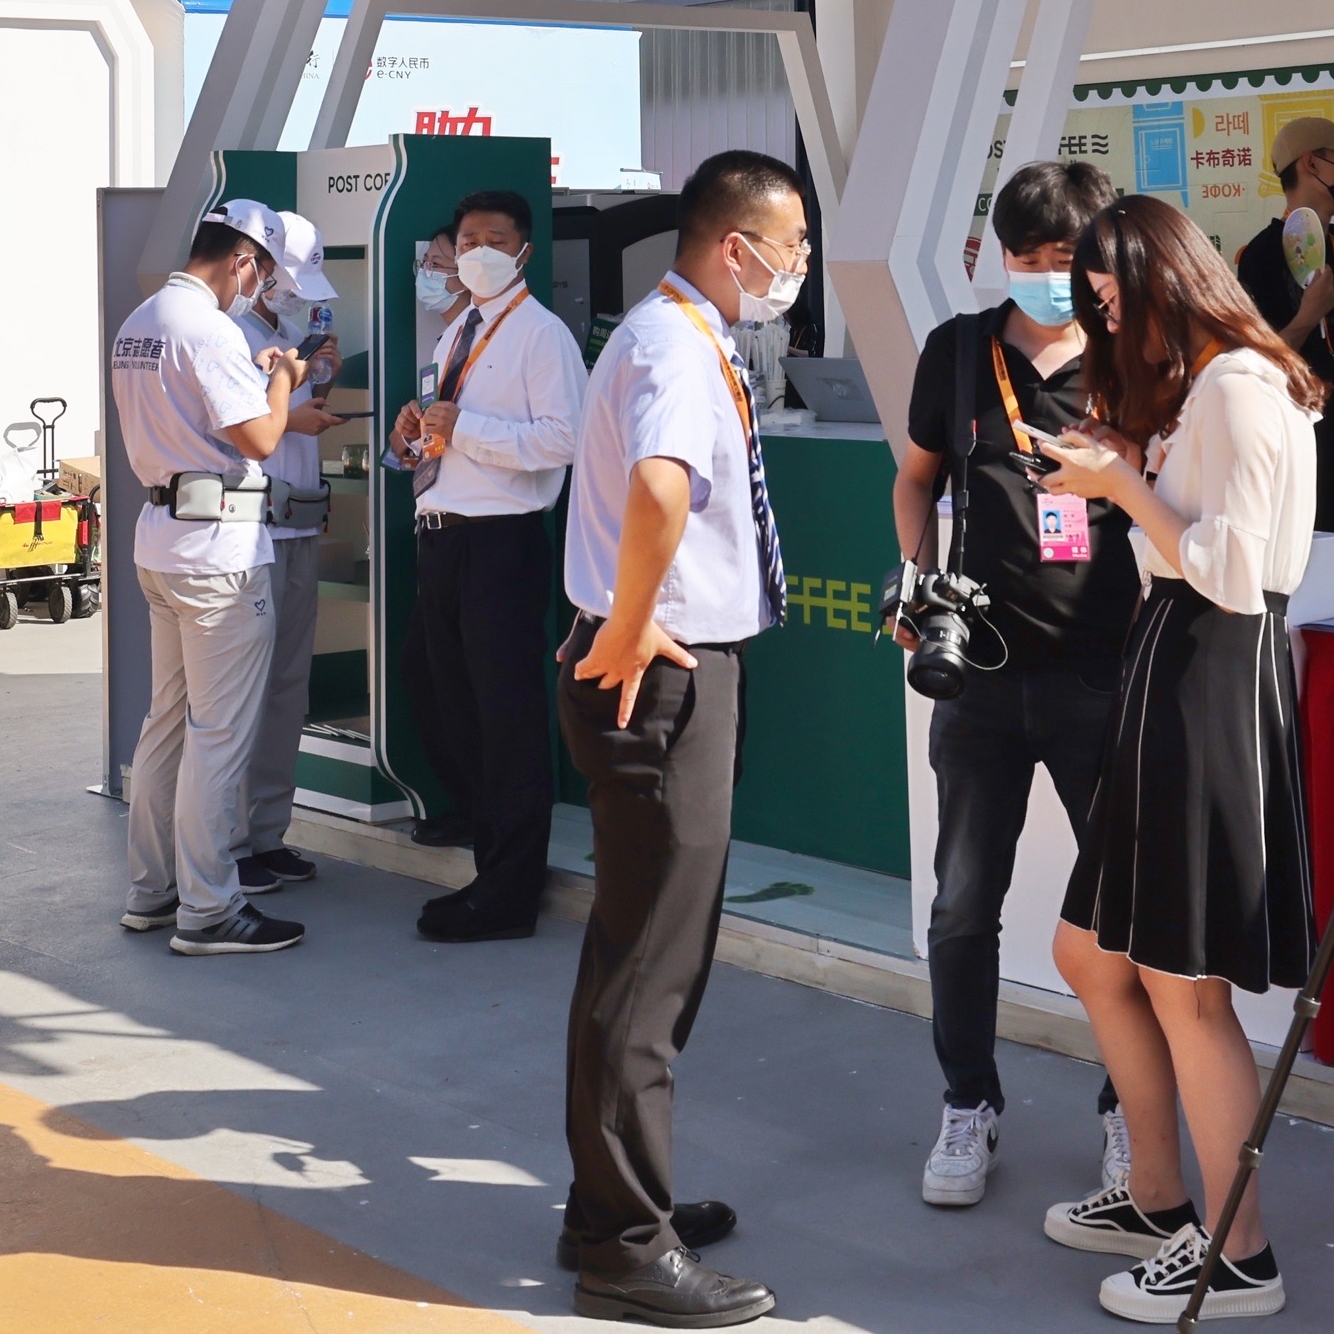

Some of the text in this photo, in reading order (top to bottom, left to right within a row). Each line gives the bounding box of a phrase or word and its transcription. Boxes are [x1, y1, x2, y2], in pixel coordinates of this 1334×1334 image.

[376, 56, 429, 69] 数字人民币
[377, 70, 411, 79] e-CNY
[1215, 112, 1250, 136] 라떼
[1190, 148, 1252, 169] 卡布奇诺
[328, 176, 360, 194] POST
[114, 337, 166, 359] 北京志愿者
